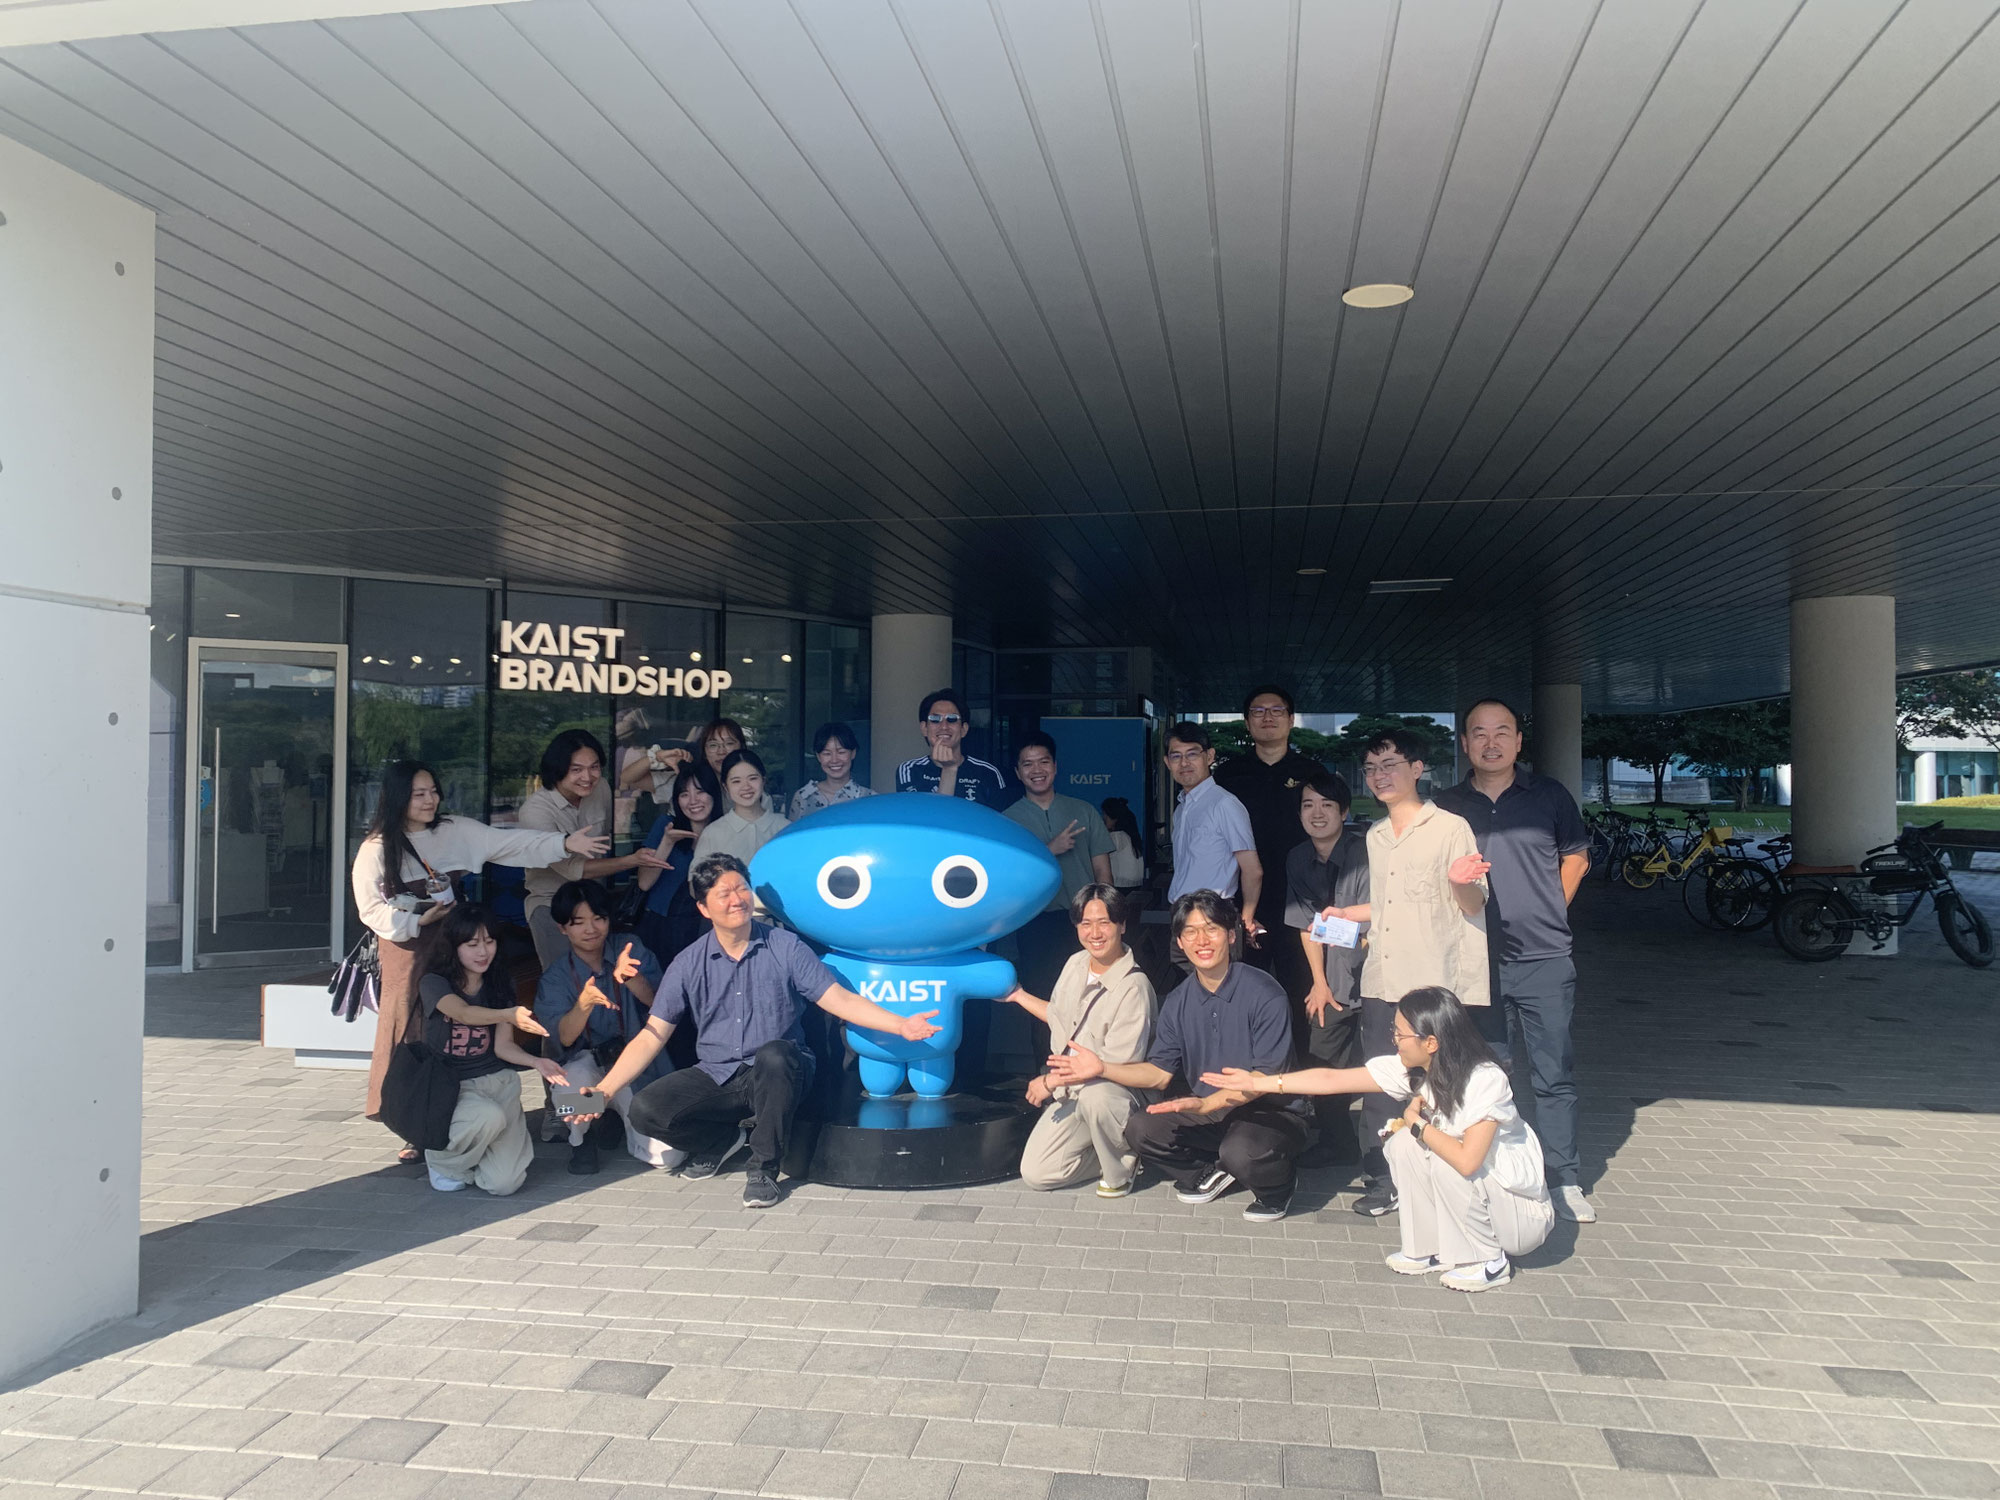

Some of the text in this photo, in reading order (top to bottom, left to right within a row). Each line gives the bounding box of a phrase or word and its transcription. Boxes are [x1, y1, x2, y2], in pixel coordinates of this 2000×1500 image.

[501, 620, 625, 659] KAIST
[500, 658, 733, 699] BRANDSHOP
[1070, 774, 1112, 785] KAIST
[860, 980, 948, 1003] KAIST
